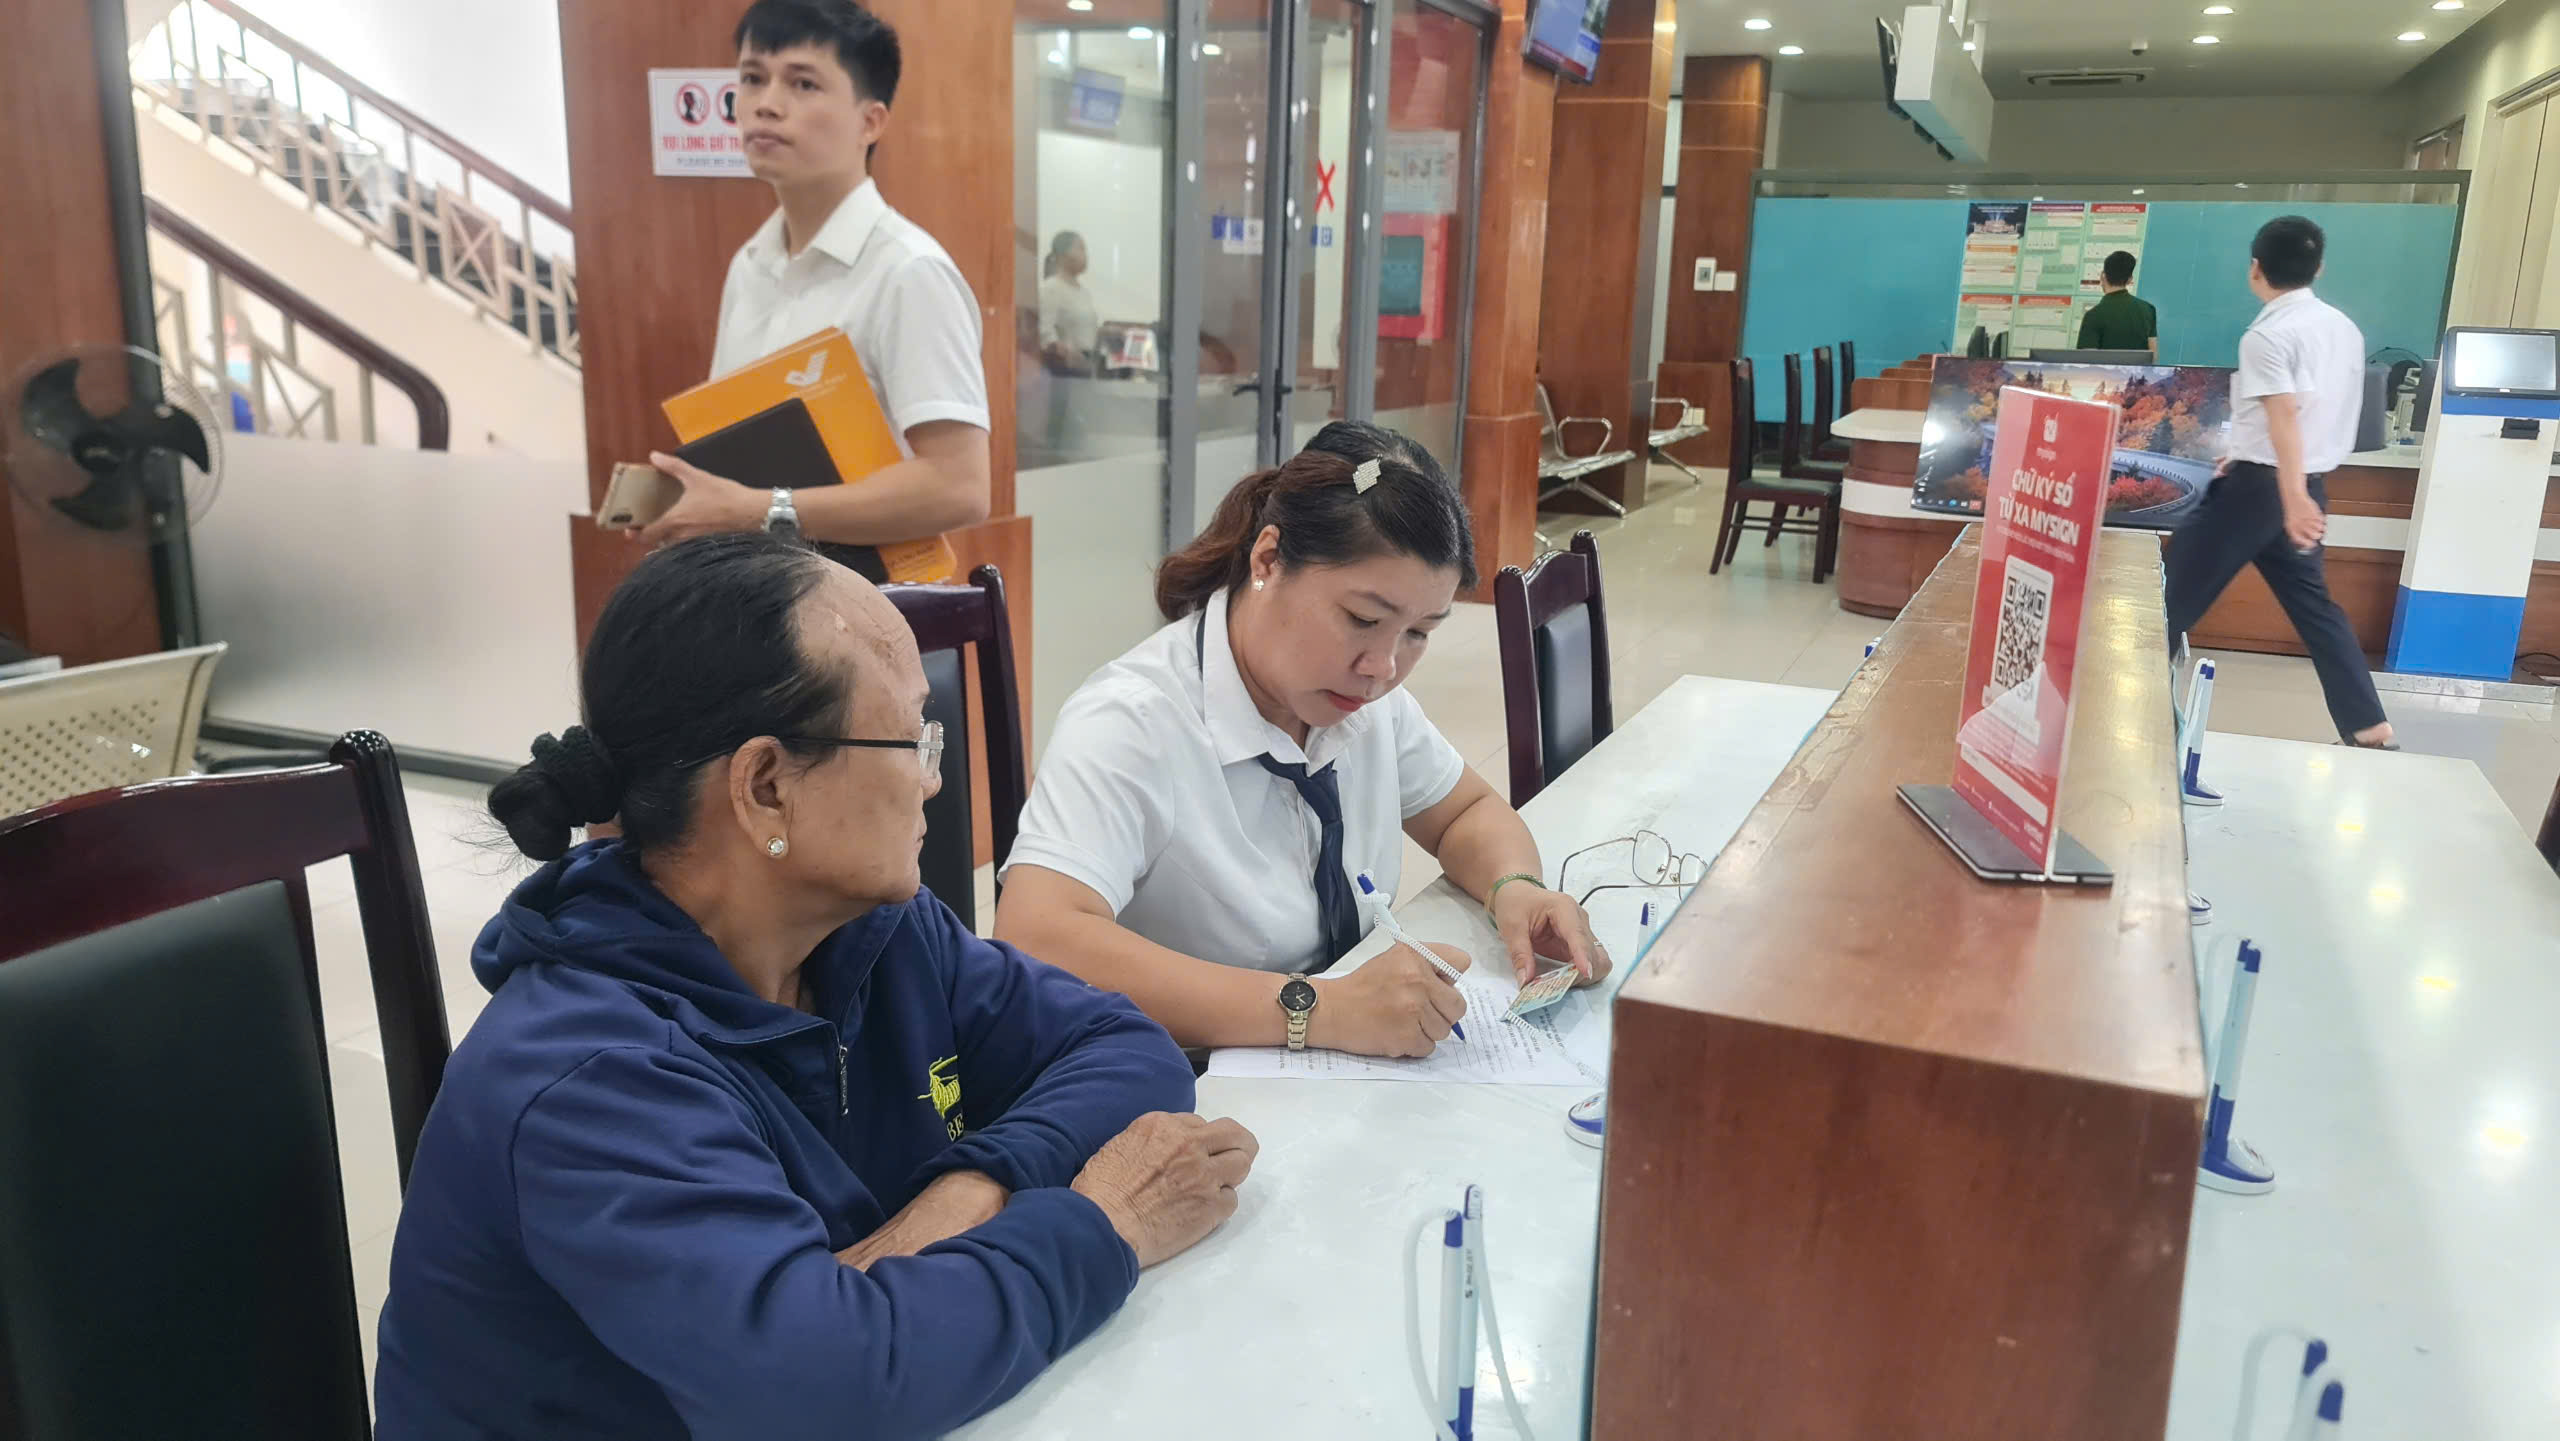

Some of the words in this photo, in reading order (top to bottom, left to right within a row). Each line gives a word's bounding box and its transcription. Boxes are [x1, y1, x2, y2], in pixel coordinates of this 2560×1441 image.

[2012, 467, 2037, 495] CHỮ
[2035, 471, 2055, 501] KÝ
[2053, 472, 2076, 507] SỐ
[1999, 491, 2015, 520] TỪ
[2013, 501, 2029, 528] XA
[2030, 508, 2080, 546] MYSIGN
[946, 1112, 964, 1142] BE
